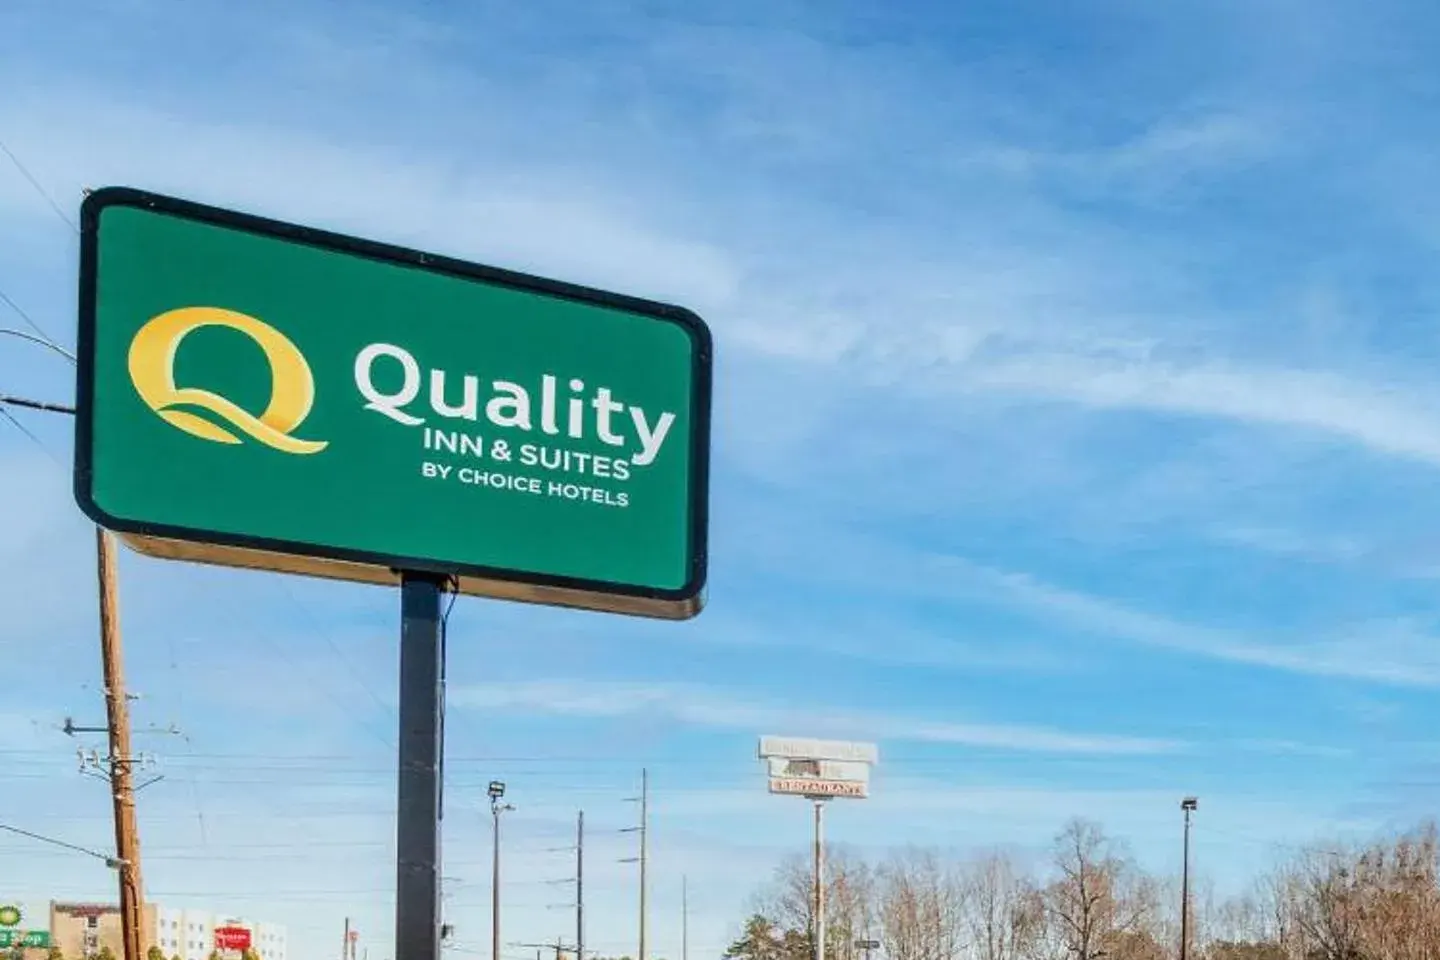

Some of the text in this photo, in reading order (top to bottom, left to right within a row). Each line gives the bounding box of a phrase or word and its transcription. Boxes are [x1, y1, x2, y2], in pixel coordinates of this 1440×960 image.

[354, 343, 676, 466] Quality
[423, 427, 630, 481] INN & SUITES
[422, 462, 628, 508] BY CHOICE HOTELS
